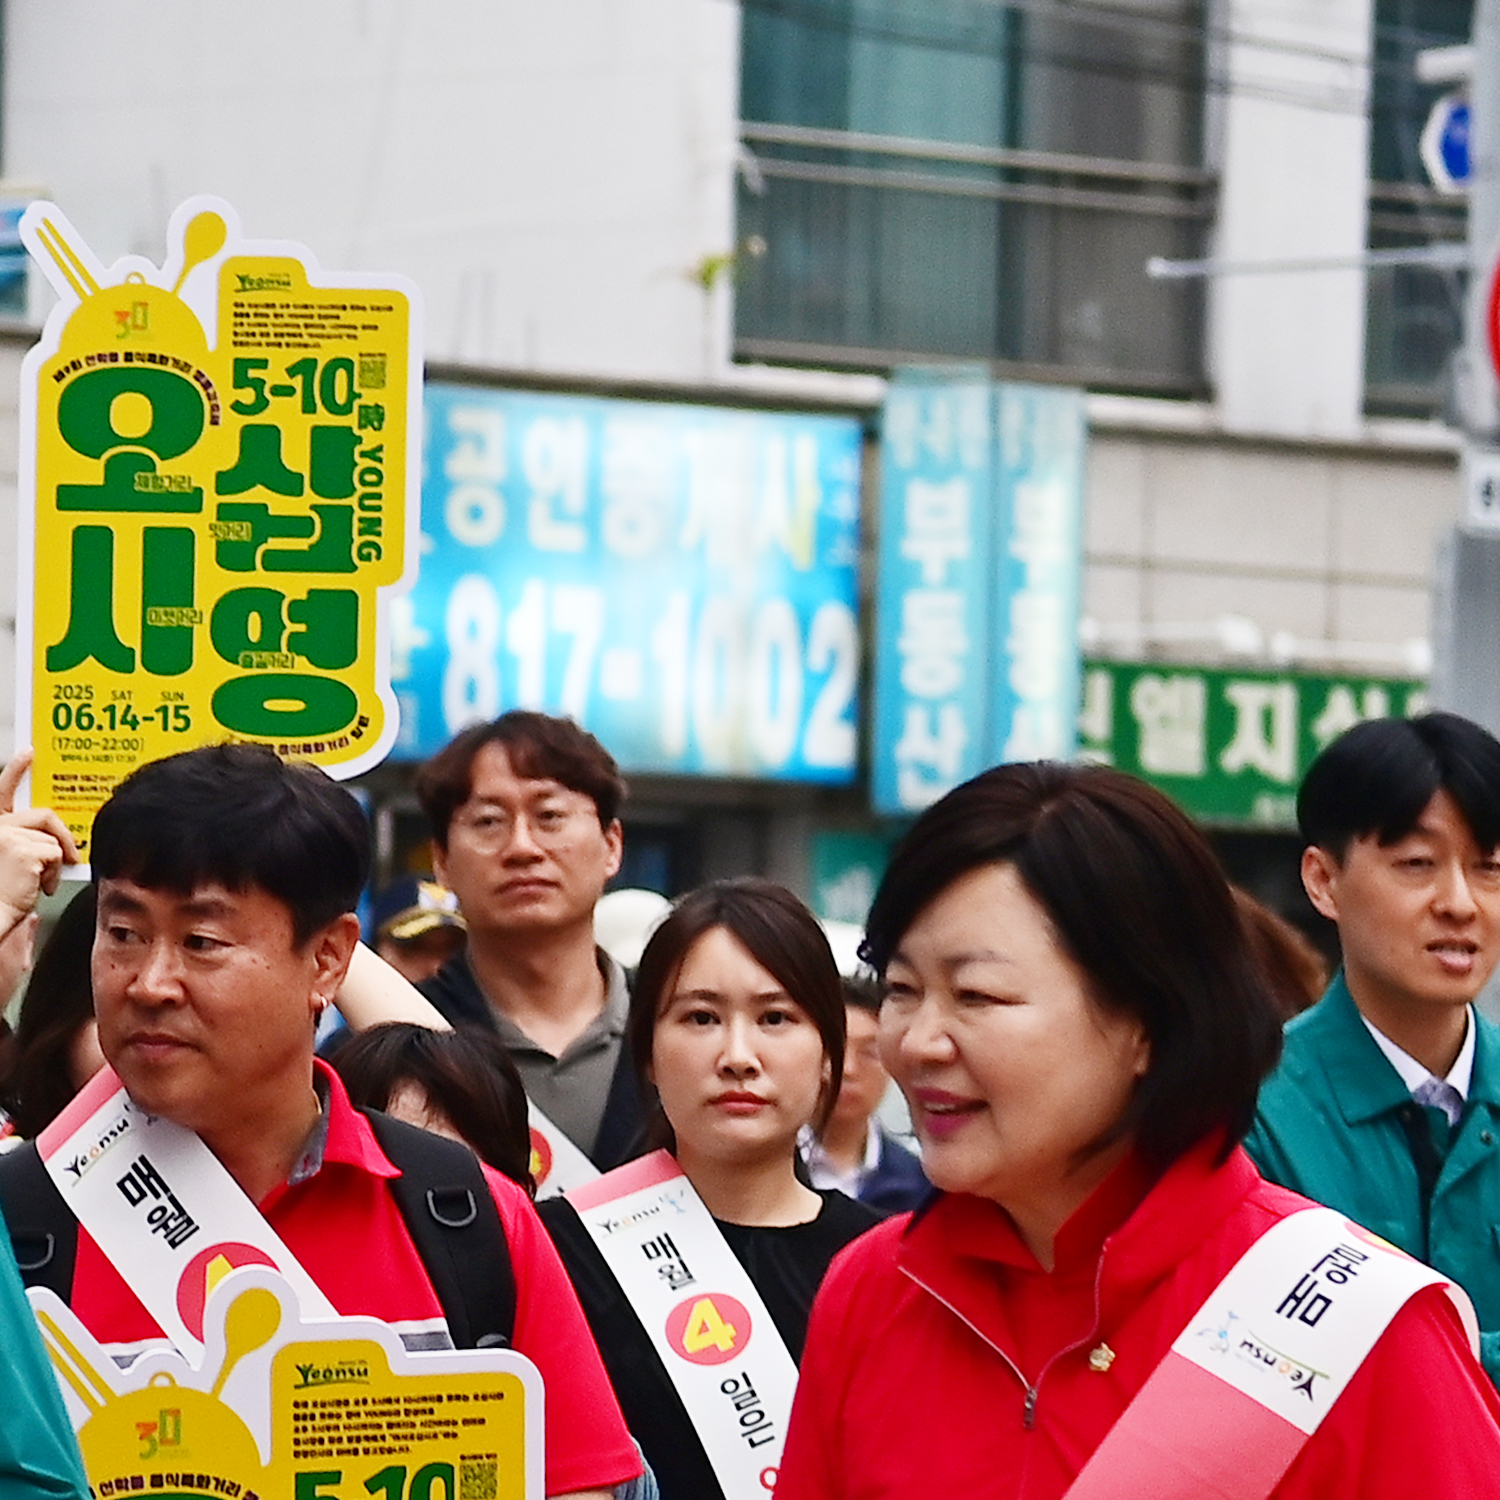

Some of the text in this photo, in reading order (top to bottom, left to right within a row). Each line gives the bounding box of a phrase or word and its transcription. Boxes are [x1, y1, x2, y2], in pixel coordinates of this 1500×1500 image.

[229, 356, 362, 417] 5-10
[356, 443, 385, 564] YOUNG
[53, 684, 94, 701] 2025
[110, 690, 185, 703] SAT SUN
[443, 573, 860, 772] 817-1002
[51, 702, 191, 733] 06.14-15
[63, 1116, 131, 1180] Yeonsu
[115, 1153, 201, 1251] 매월
[640, 1231, 699, 1293] 매월
[682, 1297, 738, 1354] 4
[293, 1361, 370, 1390] Yeonsu
[1238, 1330, 1331, 1403] Yeonsu
[719, 1370, 778, 1450] 일은
